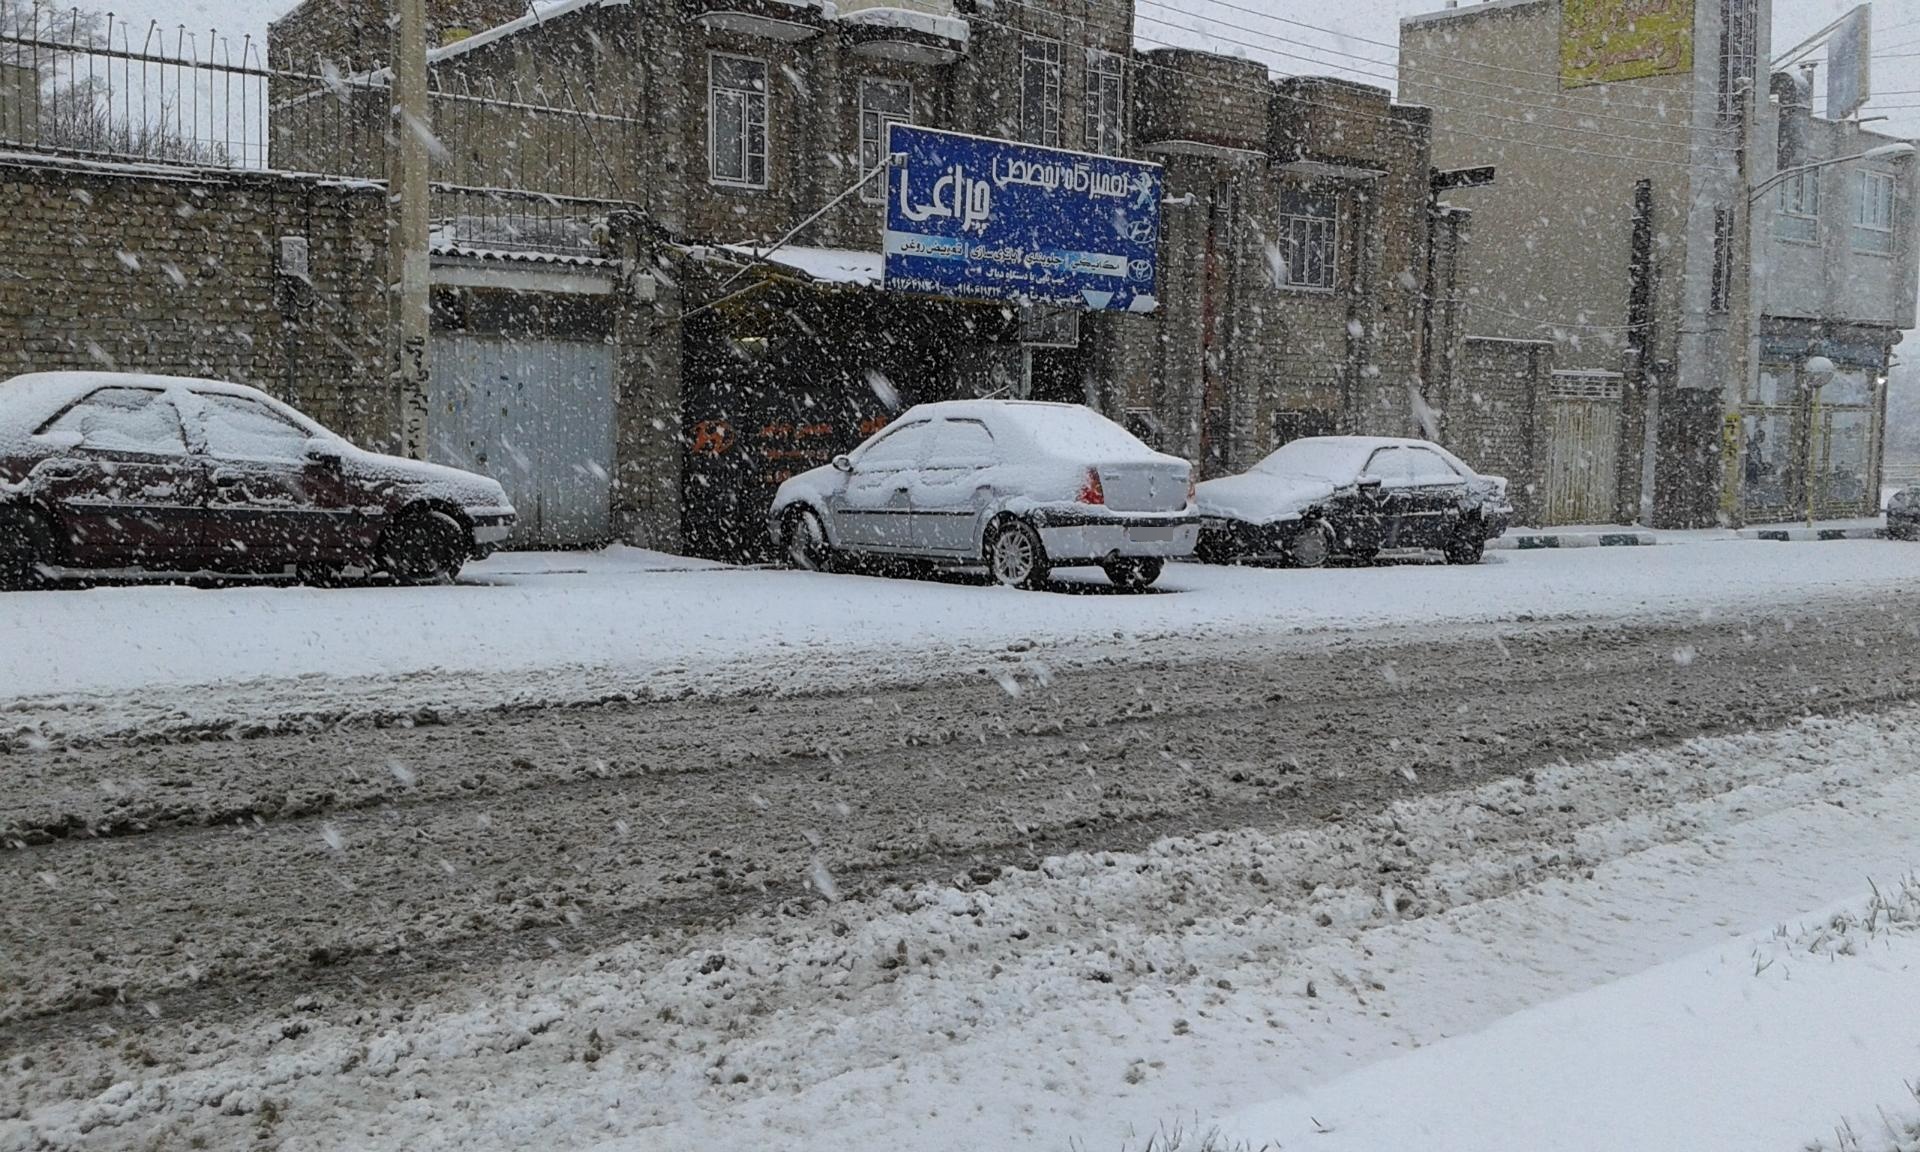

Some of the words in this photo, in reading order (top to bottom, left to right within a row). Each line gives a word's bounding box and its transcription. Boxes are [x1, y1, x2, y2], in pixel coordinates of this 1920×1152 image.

[991, 157, 1062, 190] تخصصی
[1063, 162, 1129, 200] تعمیرگاه
[901, 163, 991, 237] چراغی
[901, 239, 926, 255] روغن
[926, 242, 963, 257] تعویض
